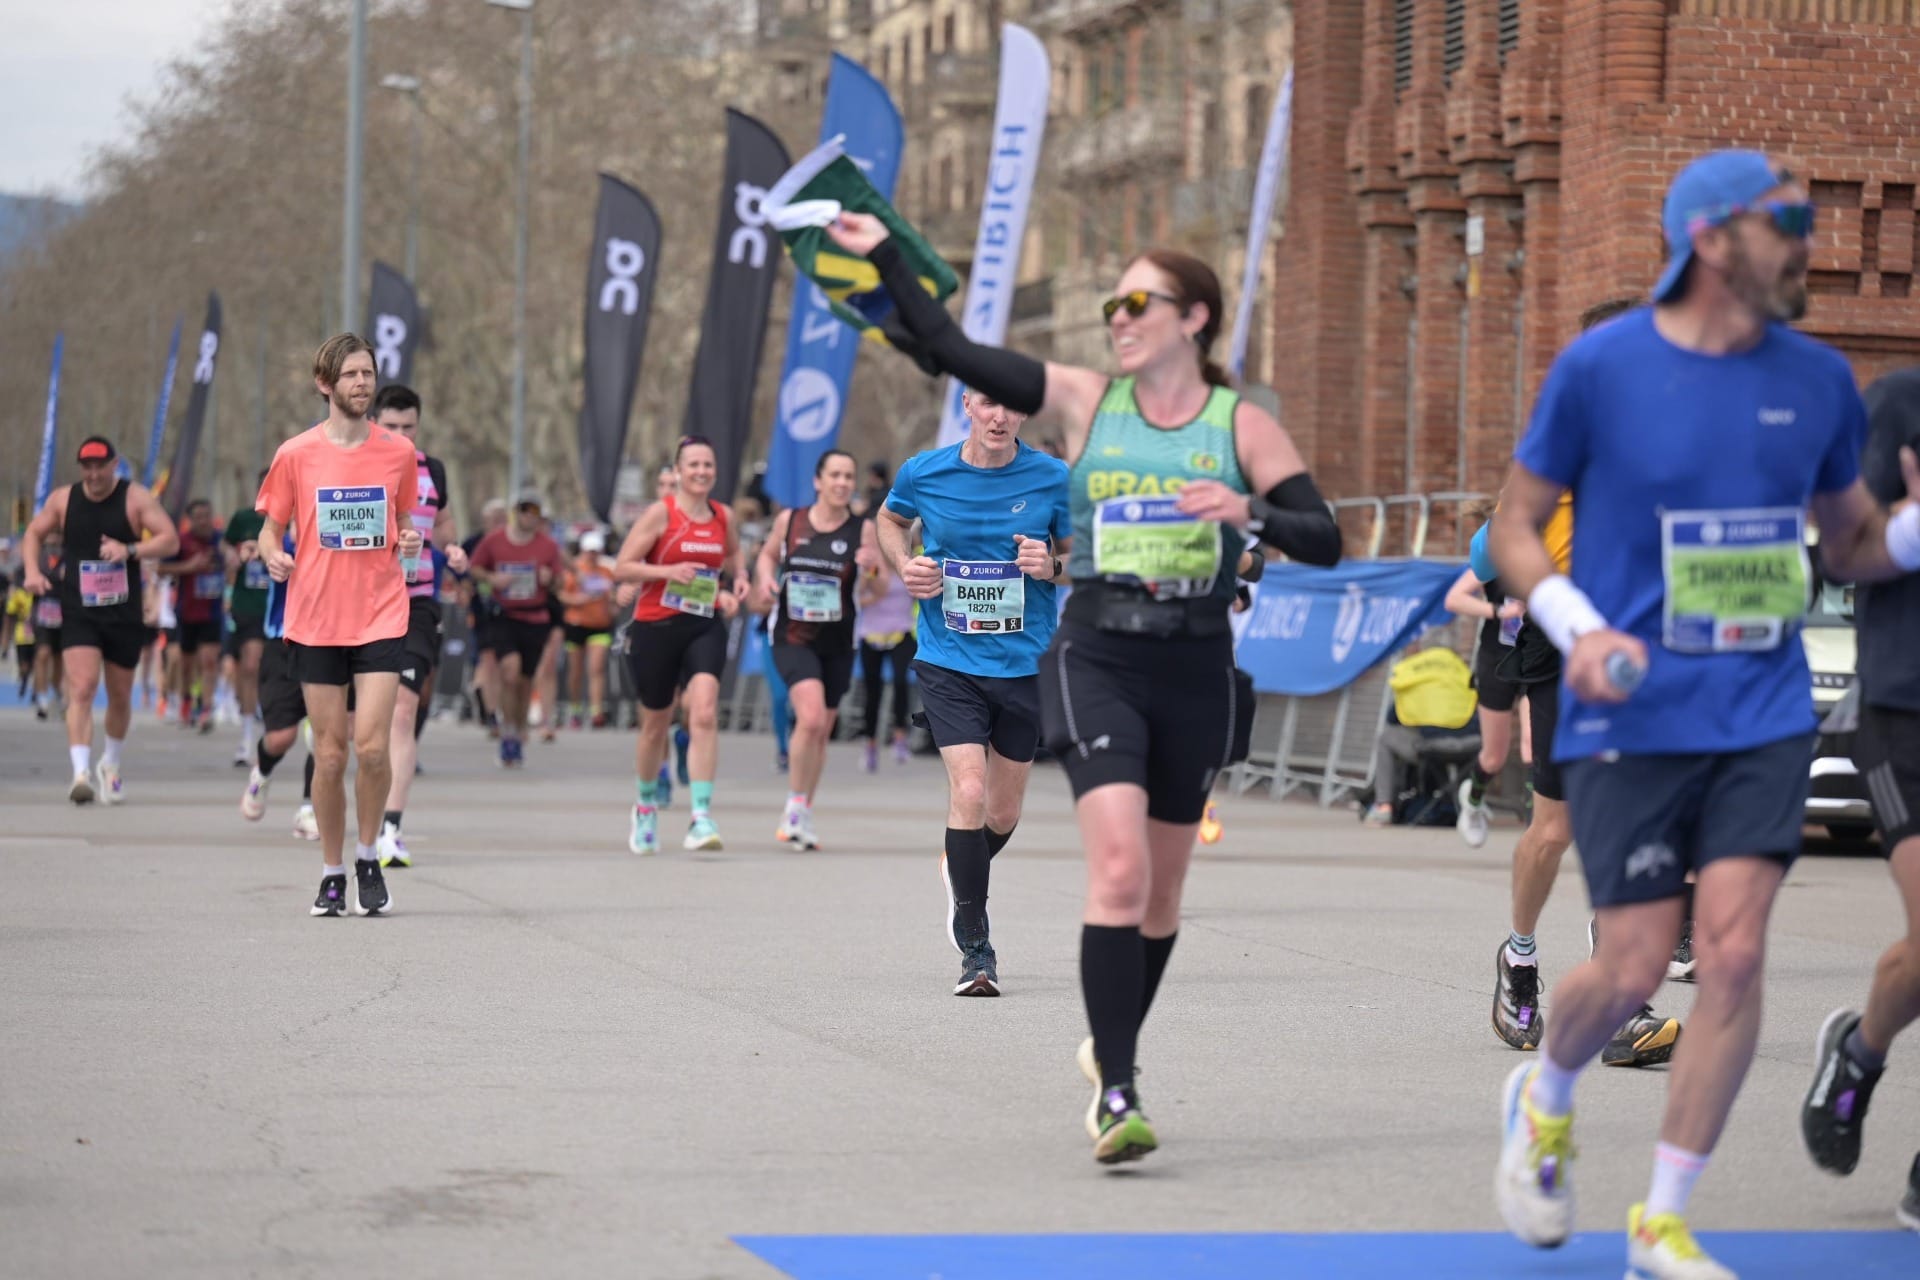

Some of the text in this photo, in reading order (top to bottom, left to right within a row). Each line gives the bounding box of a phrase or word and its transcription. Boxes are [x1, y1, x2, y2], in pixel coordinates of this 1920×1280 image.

[1087, 469, 1190, 502] BRAS
[344, 491, 371, 499] ZURICH
[330, 507, 375, 521] KRILON
[341, 522, 366, 531] 14540
[973, 567, 1003, 575] ZURICH
[1688, 557, 1791, 586] THOMAS
[957, 585, 1006, 601] BARRY
[967, 603, 997, 613] 18279
